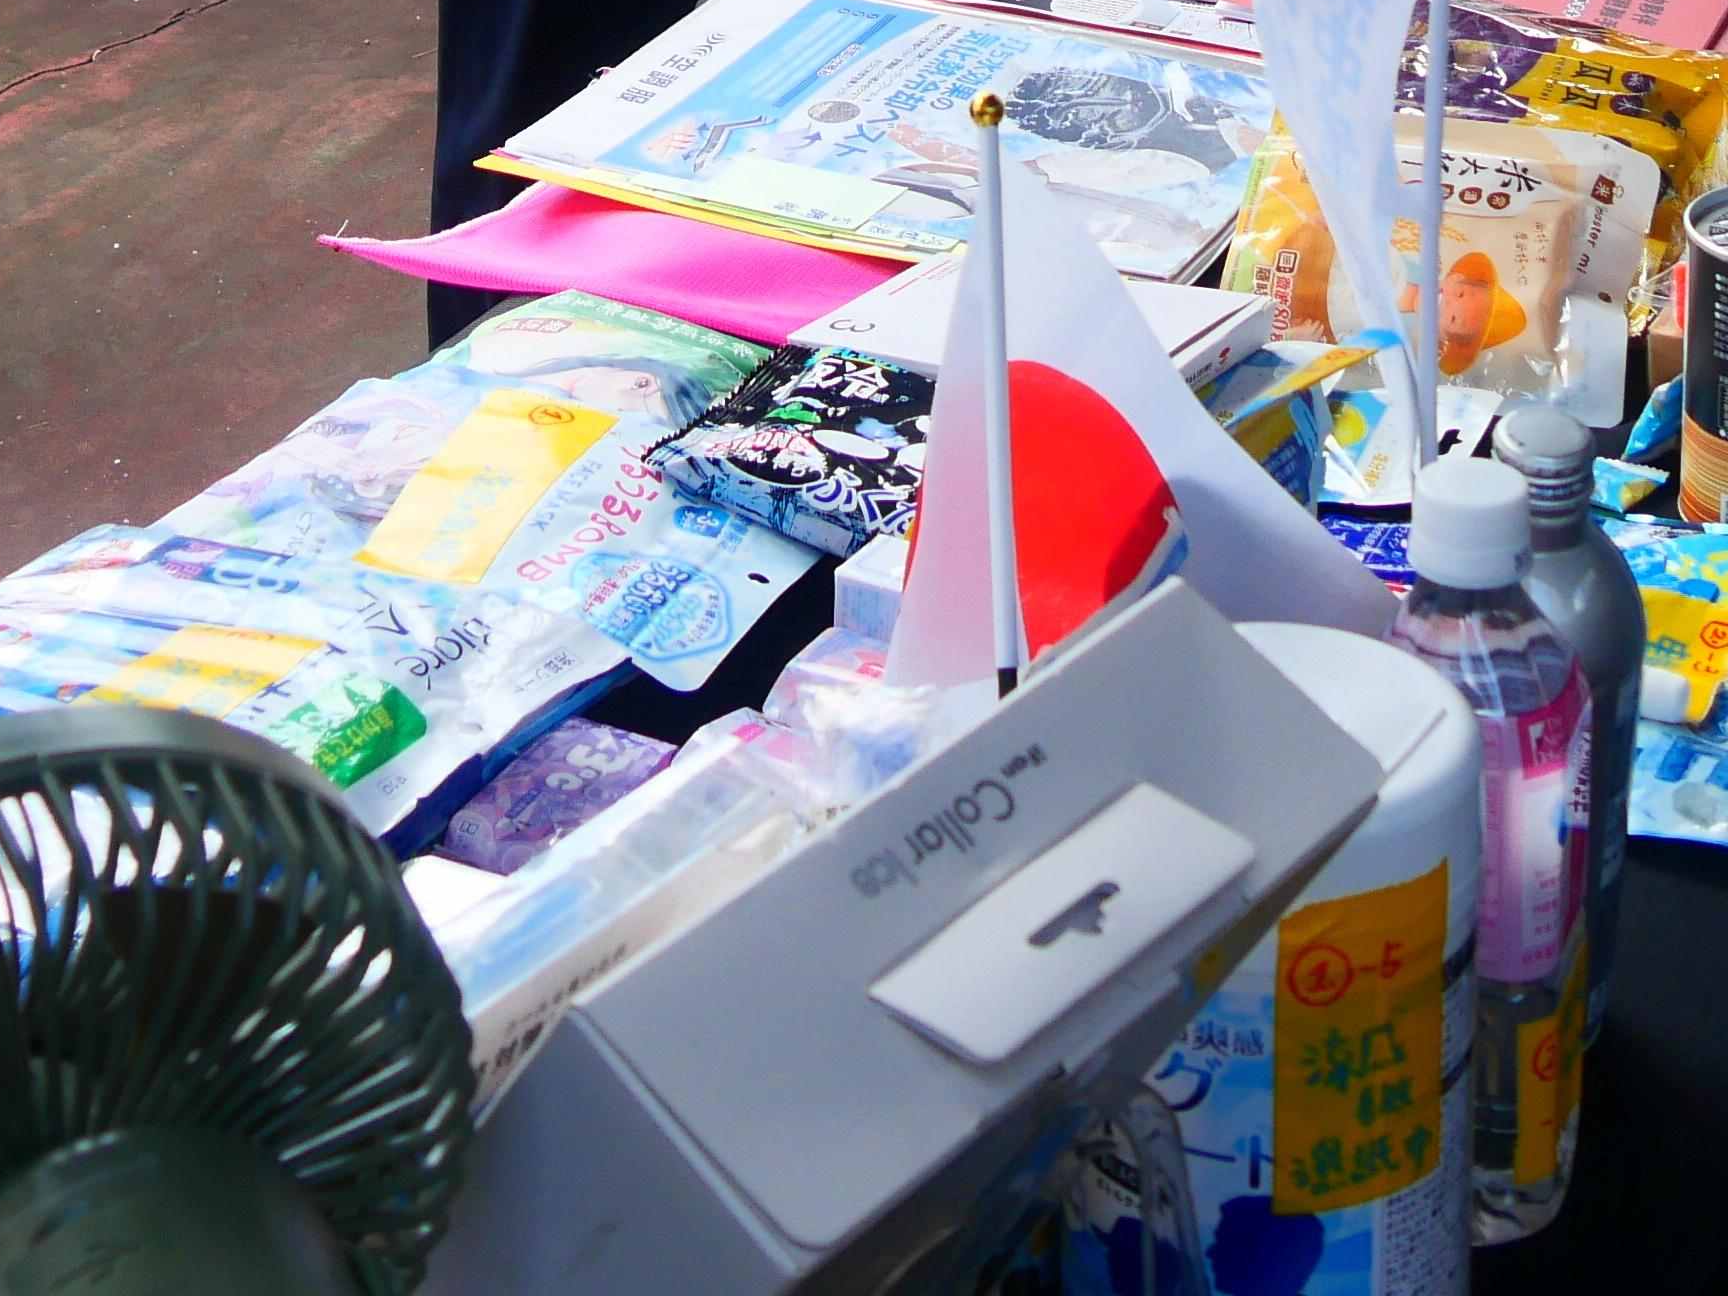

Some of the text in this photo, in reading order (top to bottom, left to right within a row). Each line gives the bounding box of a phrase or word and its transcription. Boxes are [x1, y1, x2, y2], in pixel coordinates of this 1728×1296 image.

[616, 51, 700, 106] 空調服
[833, 28, 1001, 158] 気化熱冷却ベスト
[904, 778, 1018, 862] Collar
